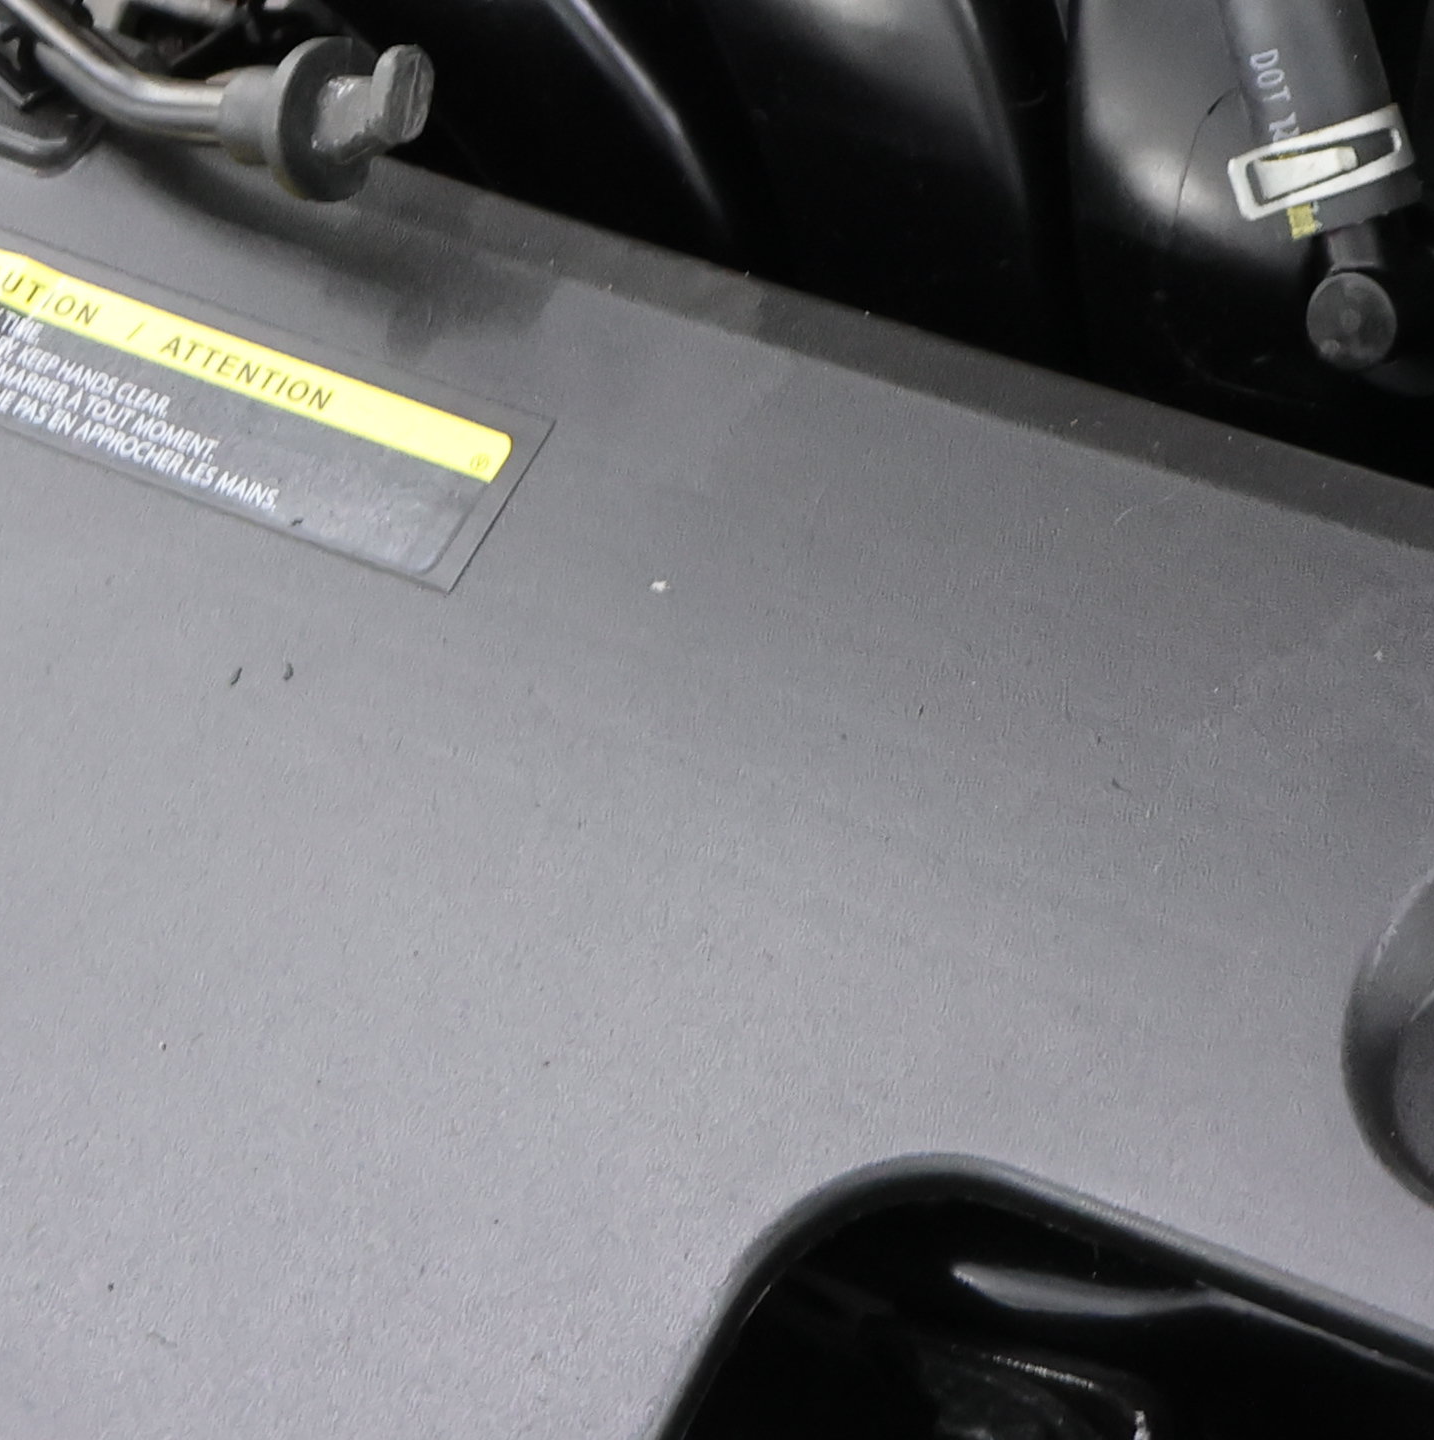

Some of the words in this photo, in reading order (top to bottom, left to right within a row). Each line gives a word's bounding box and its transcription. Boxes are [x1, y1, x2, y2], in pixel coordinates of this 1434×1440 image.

[1249, 48, 1293, 104] DOT
[16, 346, 61, 374] KEEP
[57, 359, 119, 397] HANDS
[161, 335, 334, 411] ATTENTION
[84, 393, 137, 426] TOUT
[13, 395, 53, 425] PAS
[47, 409, 79, 436] EN
[74, 419, 188, 477] APPROCHER
[180, 457, 219, 488] LES
